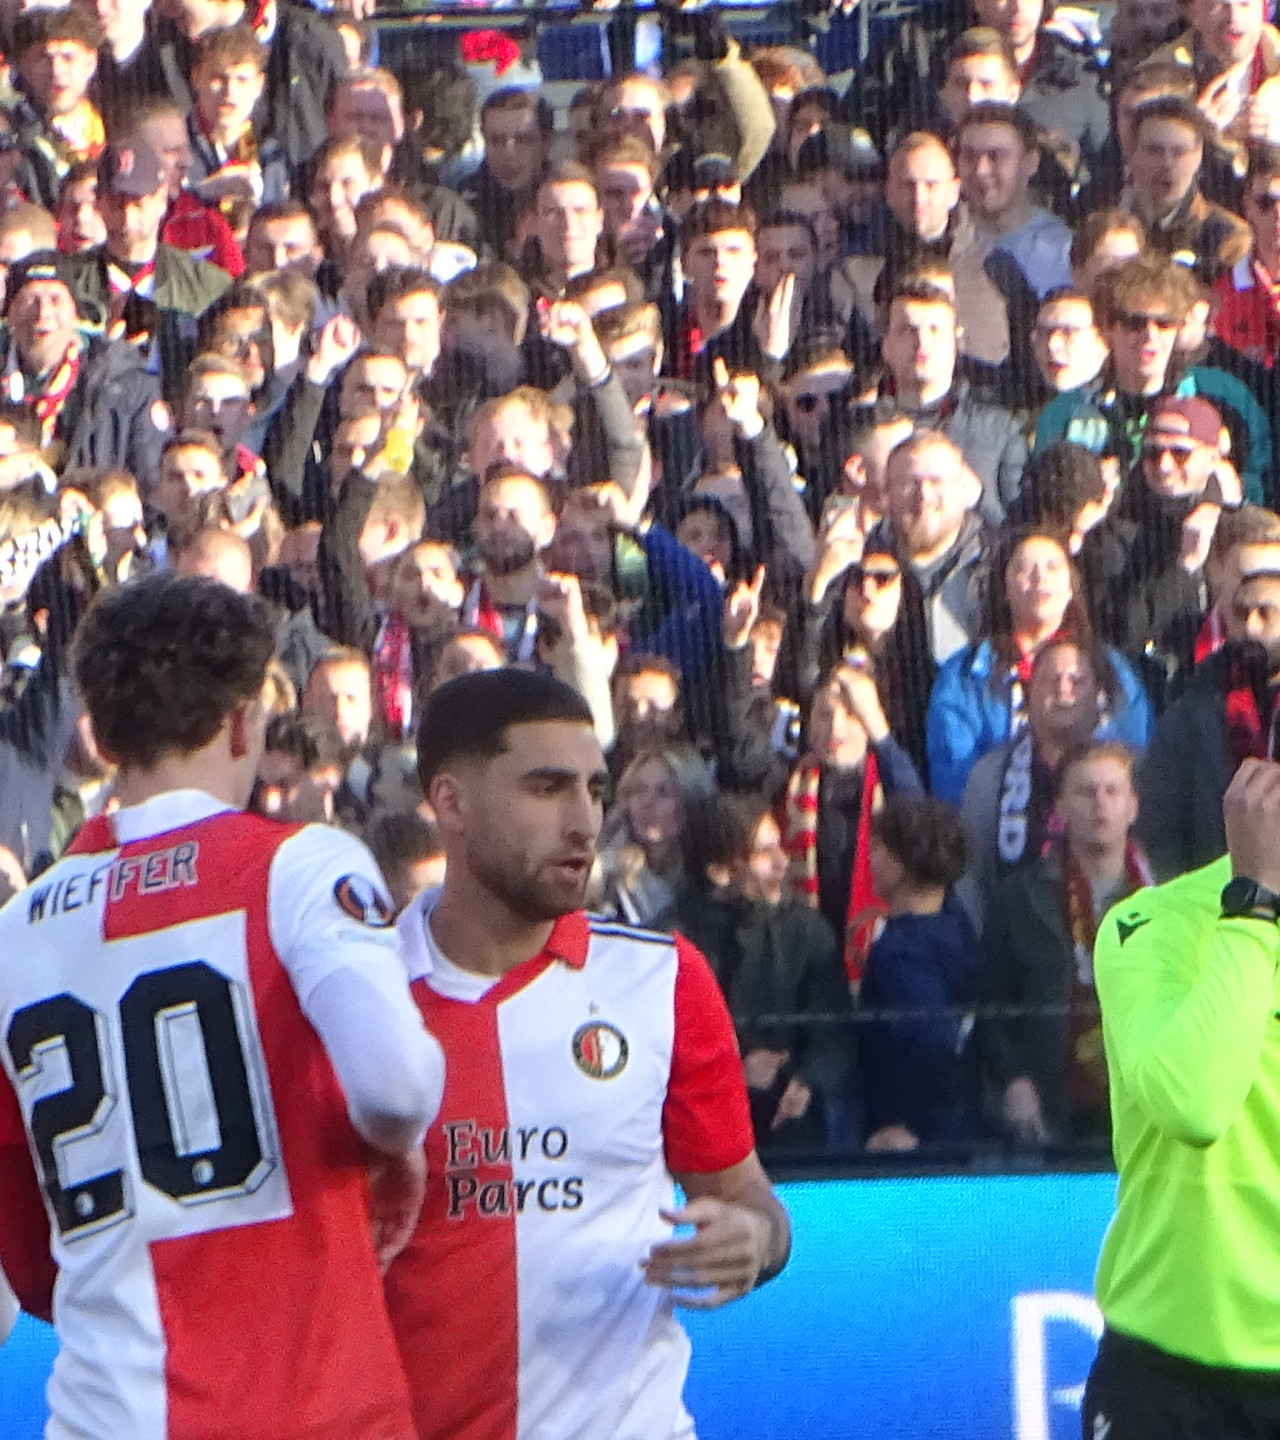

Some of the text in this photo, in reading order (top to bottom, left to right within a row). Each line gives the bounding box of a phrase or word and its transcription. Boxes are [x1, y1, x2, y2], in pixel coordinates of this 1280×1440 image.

[28, 840, 200, 925] WIEFFER
[7, 960, 277, 1243] 20
[443, 1119, 569, 1172] Euro
[446, 1169, 584, 1221] Parcs
